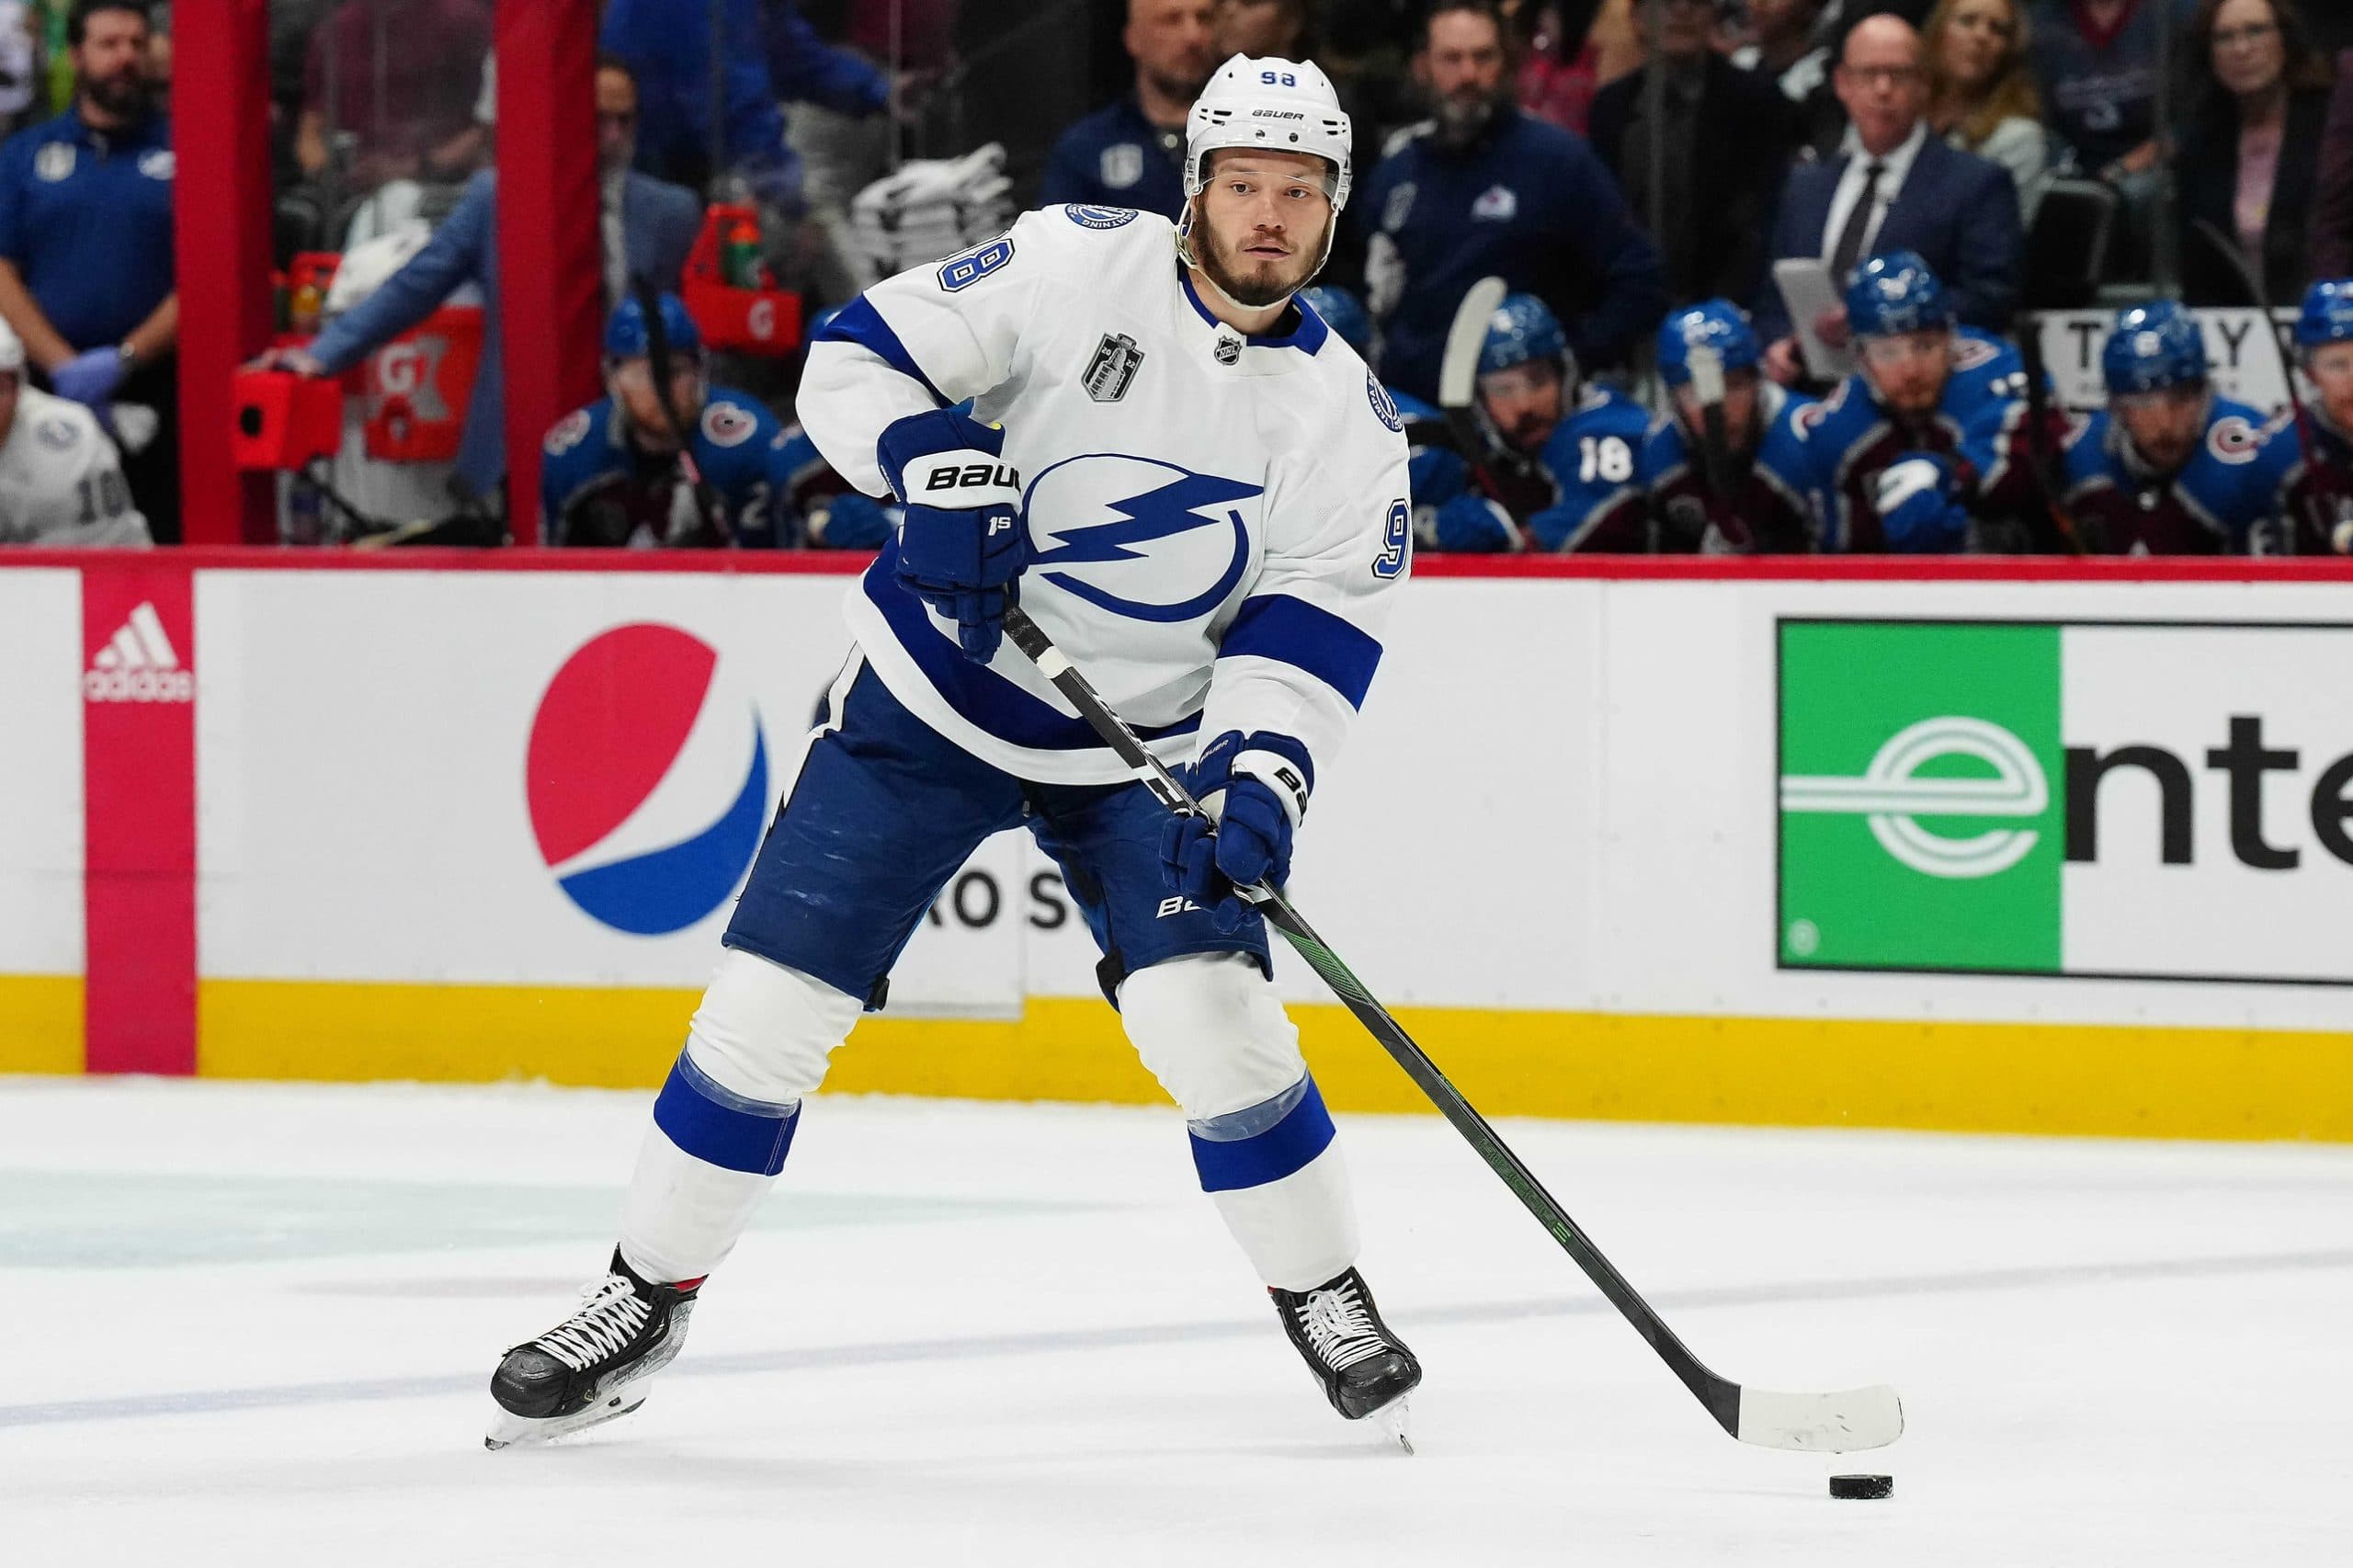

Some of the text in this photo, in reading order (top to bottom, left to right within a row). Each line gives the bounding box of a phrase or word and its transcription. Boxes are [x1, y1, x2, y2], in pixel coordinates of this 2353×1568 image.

[1261, 71, 1296, 87] 98
[1252, 108, 1304, 120] BAUER
[936, 233, 1016, 292] 8
[1579, 436, 1633, 483] 18
[84, 668, 195, 702] adidas
[928, 870, 1000, 928] O
